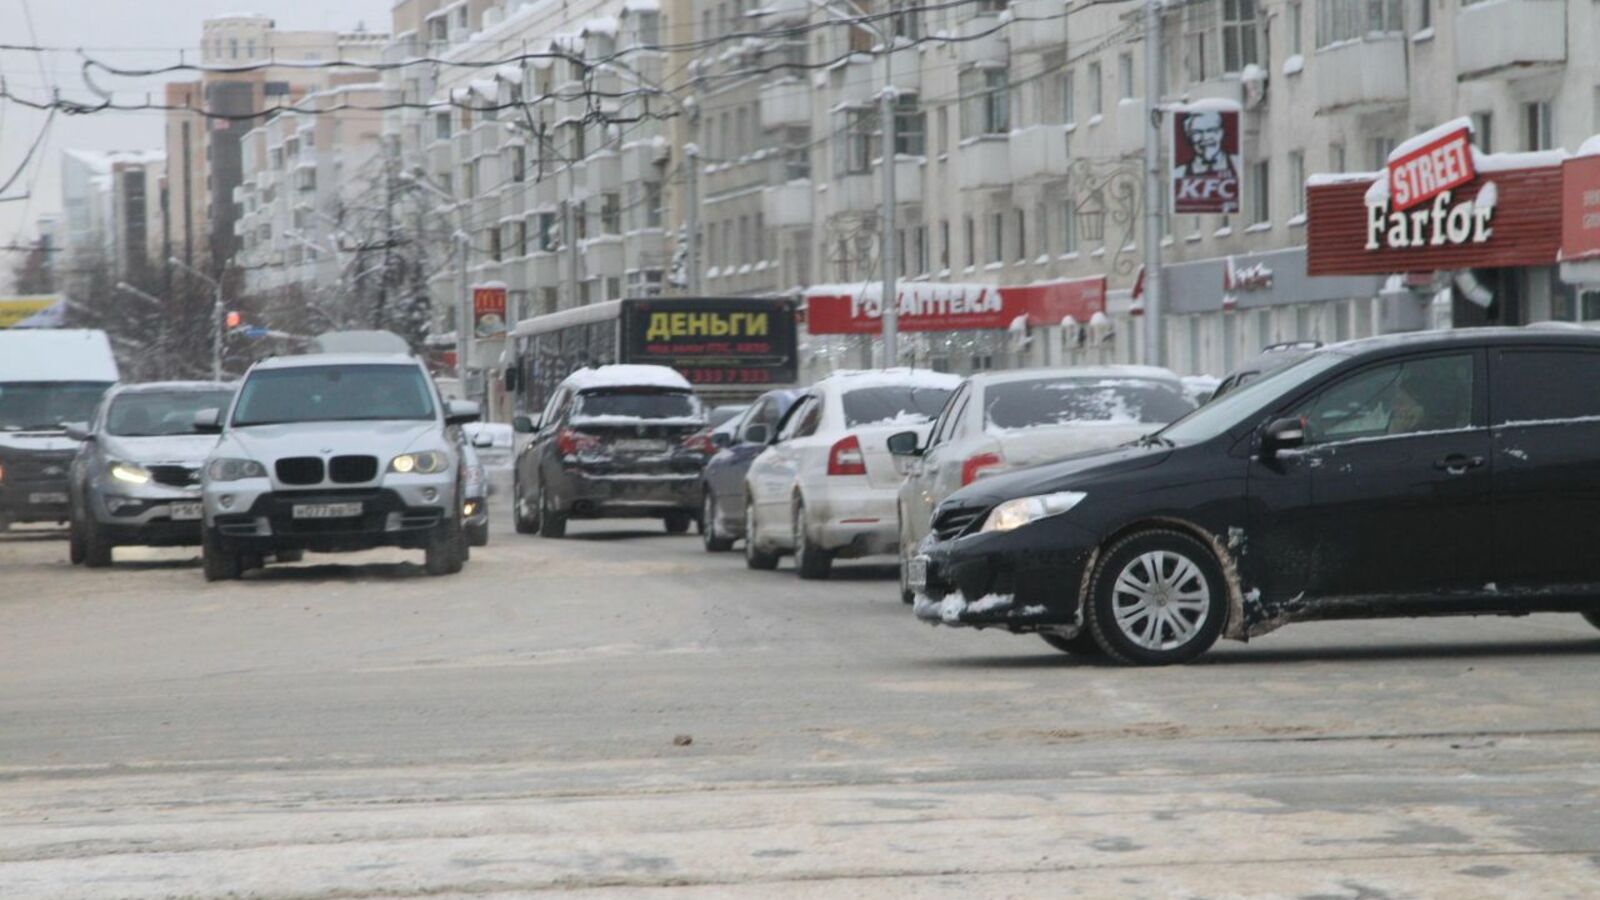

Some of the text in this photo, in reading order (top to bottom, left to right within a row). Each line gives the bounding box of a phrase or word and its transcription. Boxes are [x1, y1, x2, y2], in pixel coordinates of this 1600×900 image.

[1393, 137, 1468, 205] STREET
[1178, 179, 1237, 199] KFC
[1364, 190, 1494, 250] Farfor
[851, 287, 1002, 318] ГОАПТЕКА
[646, 312, 768, 341] ДЕНЬГИ
